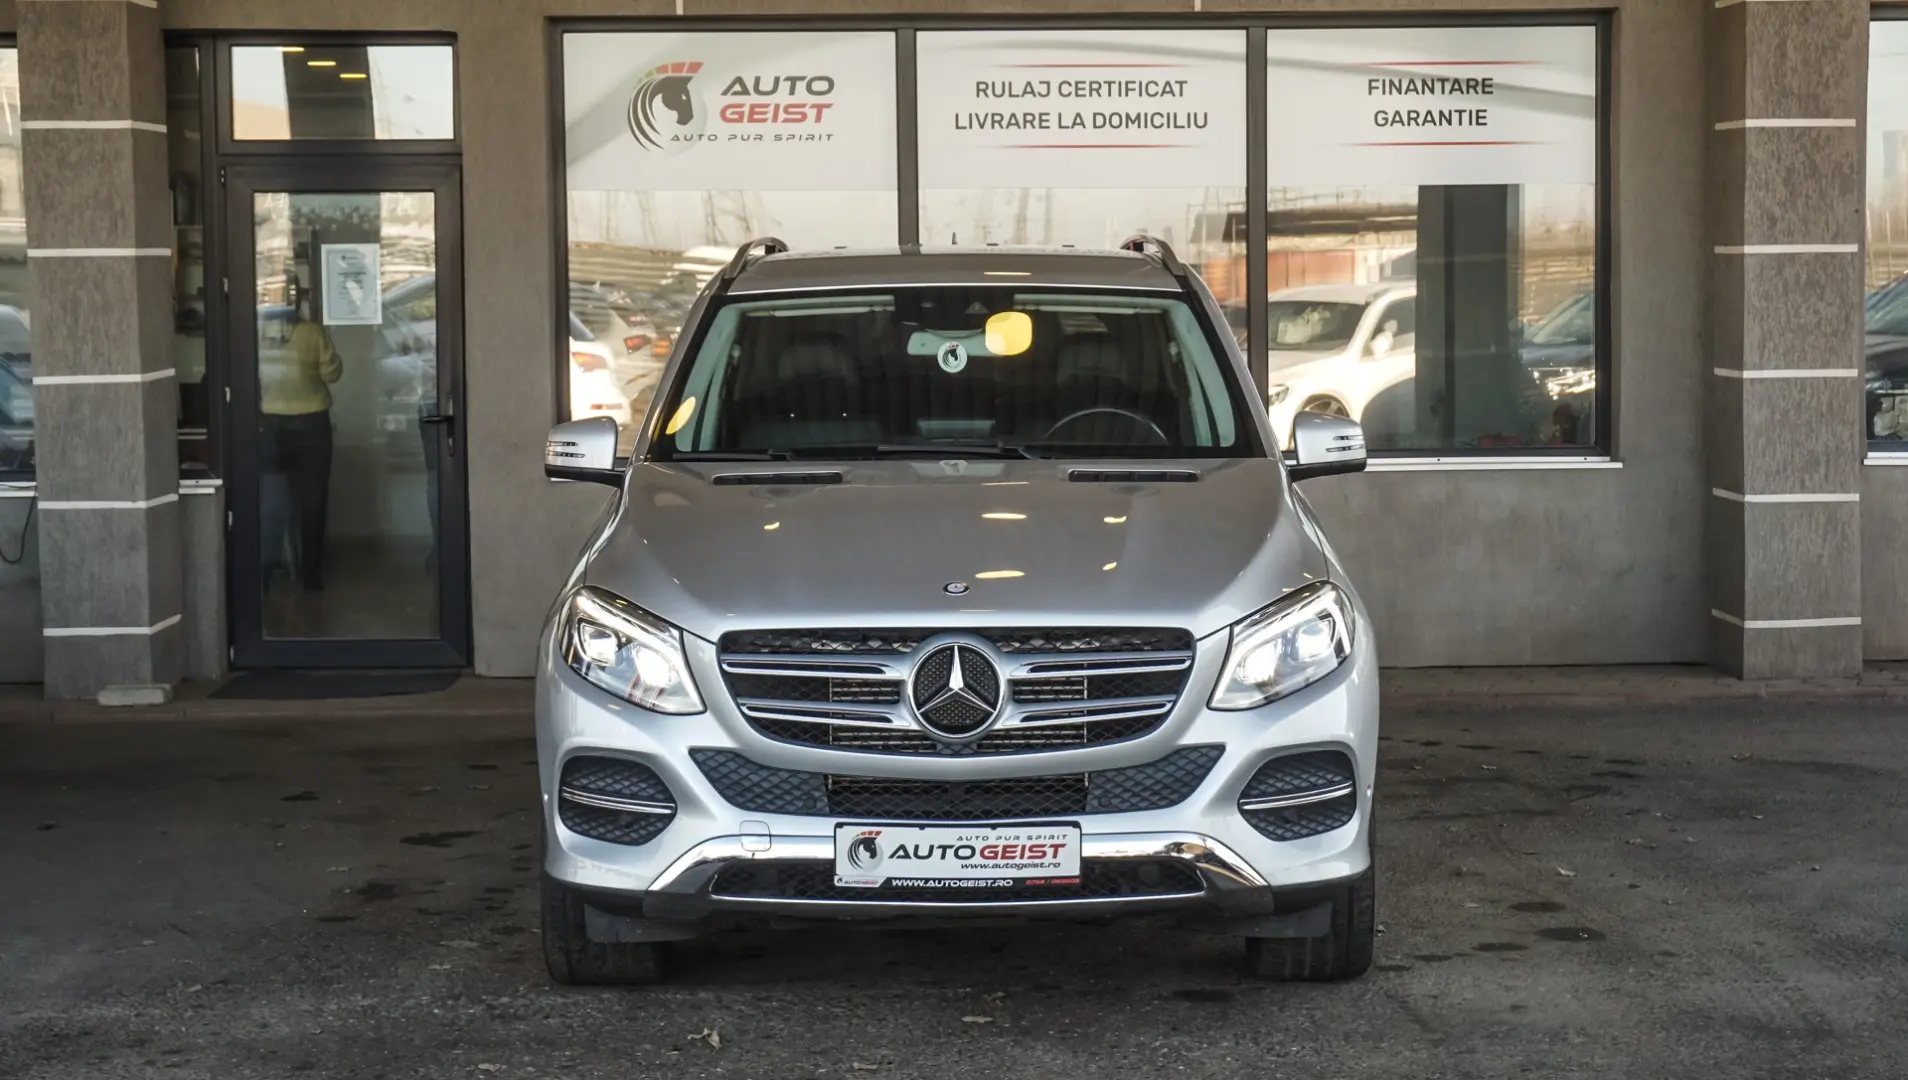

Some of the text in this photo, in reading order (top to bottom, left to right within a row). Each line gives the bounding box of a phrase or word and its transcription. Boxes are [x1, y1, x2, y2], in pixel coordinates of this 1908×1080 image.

[720, 76, 835, 96] AUTO
[975, 80, 1188, 98] RULAJ CERTIFICAT
[1368, 77, 1494, 95] FINANTARE
[719, 103, 834, 124] GEIST
[954, 111, 1208, 130] LIVRARE LA DOMICILIU
[1373, 109, 1488, 127] GARANTIE
[670, 133, 835, 142] AUTO PUR SPIRIT
[960, 860, 1062, 871] www.autogeist.ro
[892, 878, 1014, 887] WWW.AUTOGEIST.RO
